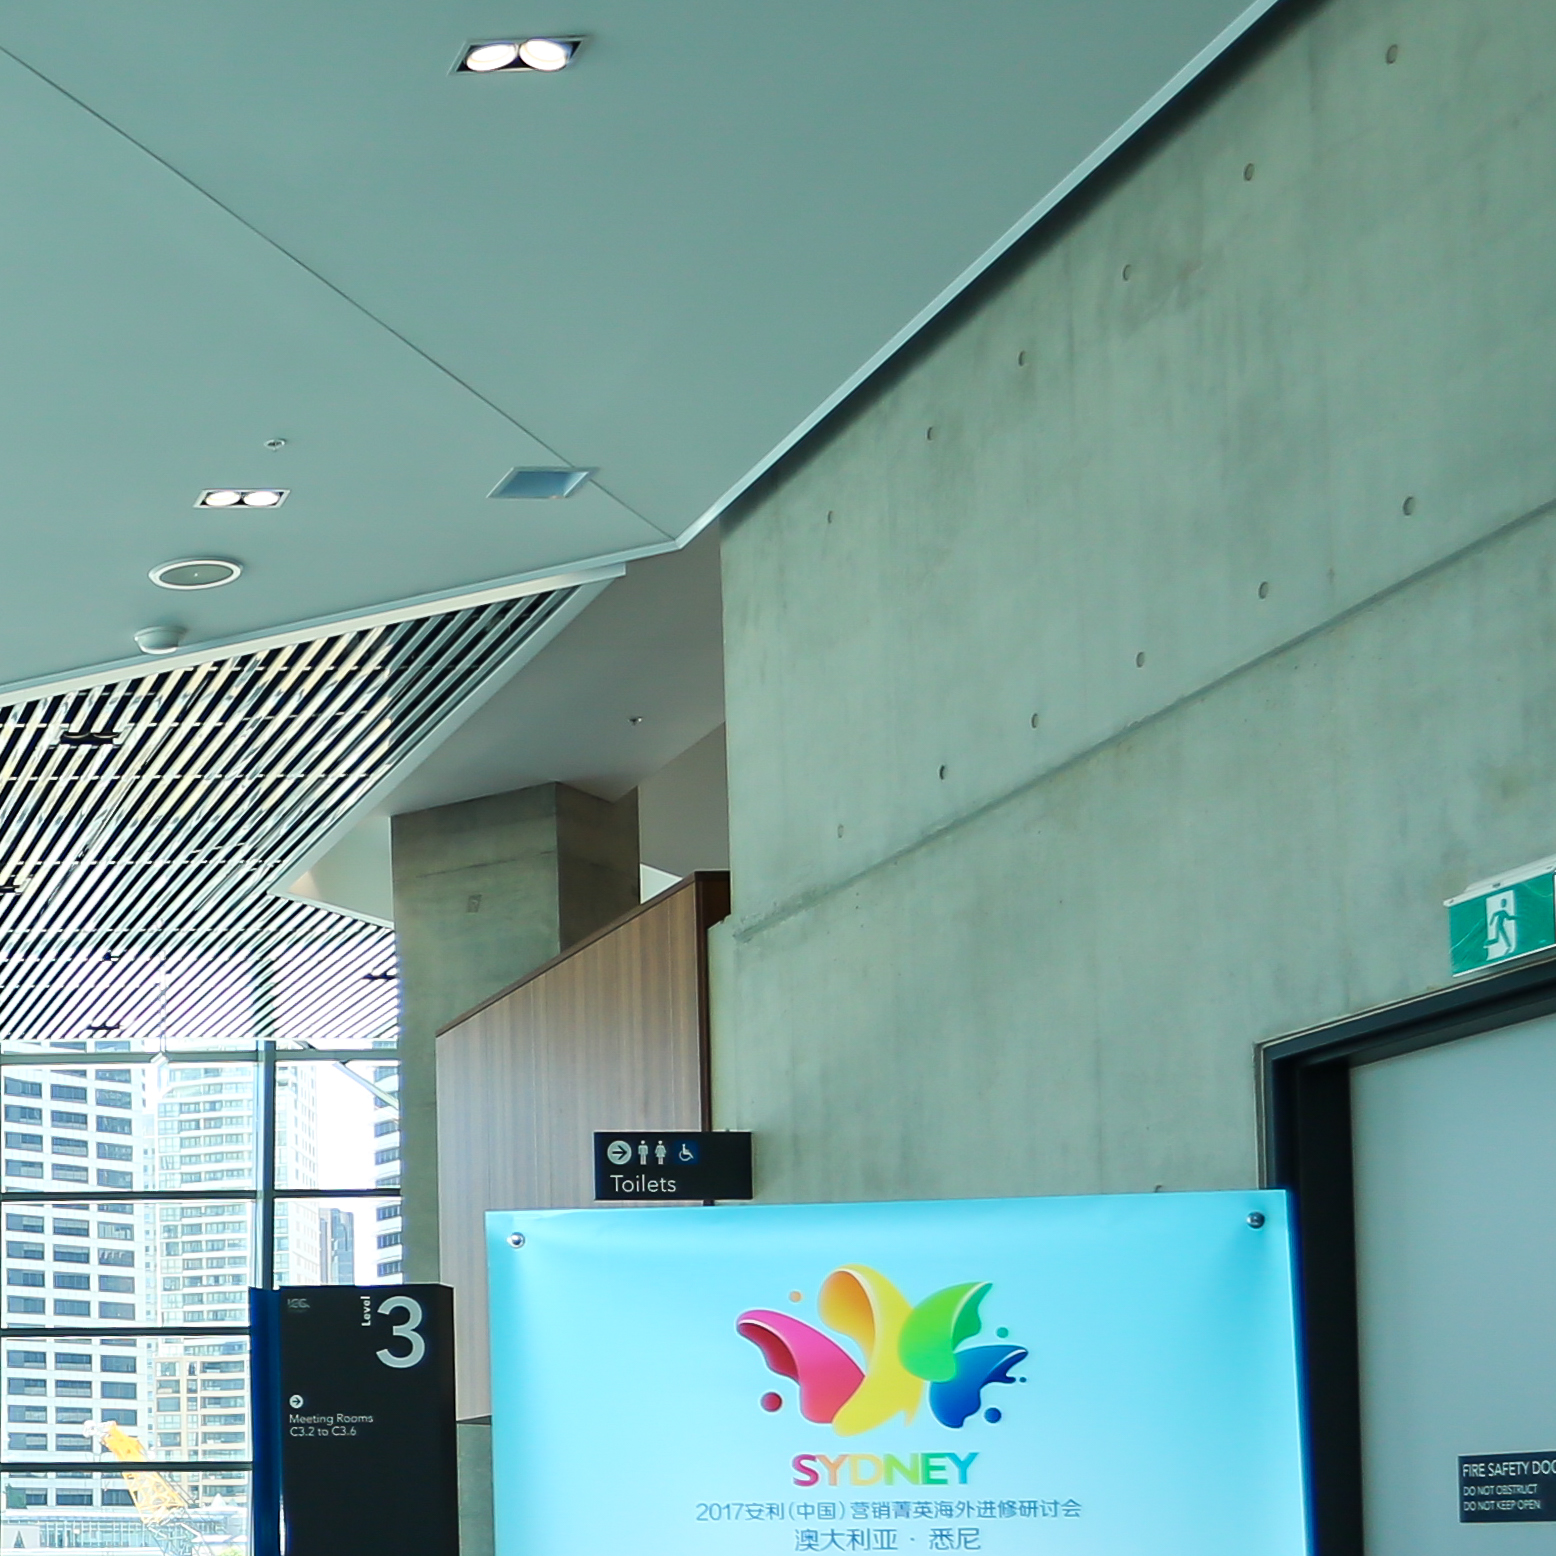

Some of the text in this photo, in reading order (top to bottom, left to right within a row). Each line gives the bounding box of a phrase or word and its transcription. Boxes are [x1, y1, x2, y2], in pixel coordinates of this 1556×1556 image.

[609, 1174, 677, 1193] Toilets
[360, 1295, 426, 1369] Level 3
[289, 1413, 374, 1426] Meeting Rooms
[289, 1425, 357, 1437] C3.2 to C3.6
[790, 1451, 980, 1487] SYDNEY
[1462, 1459, 1556, 1477] FIRE SAFETY DOO
[1463, 1483, 1538, 1496] DO NOT OBSTRUCT
[1463, 1499, 1542, 1511] DO NOT KEEP OPEN
